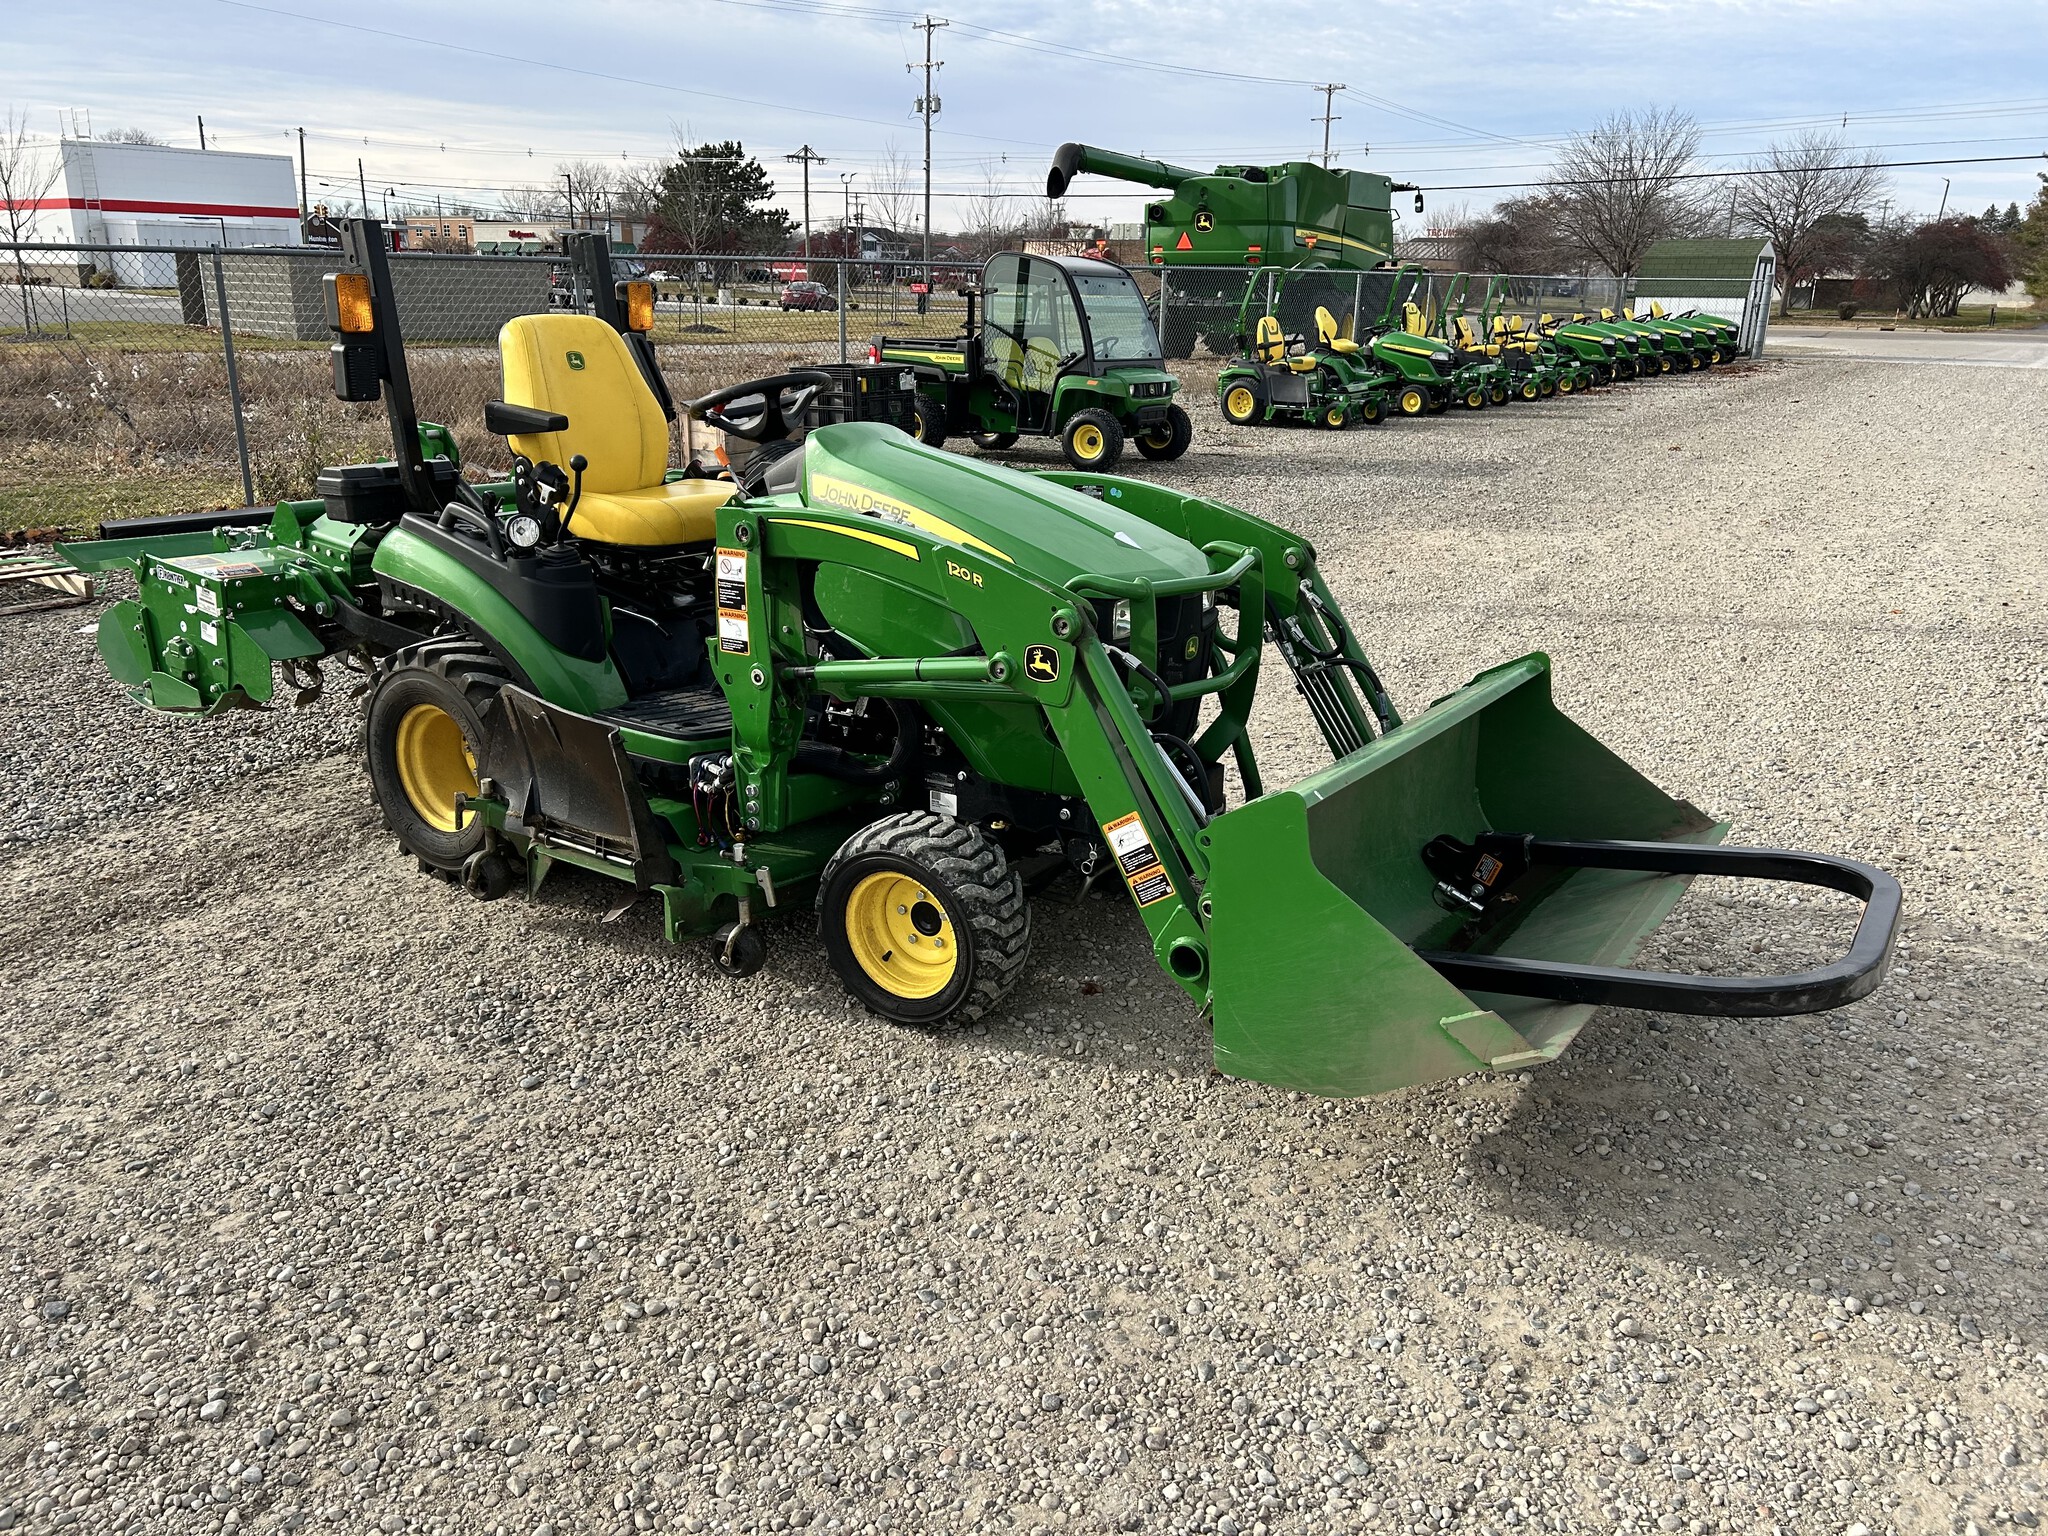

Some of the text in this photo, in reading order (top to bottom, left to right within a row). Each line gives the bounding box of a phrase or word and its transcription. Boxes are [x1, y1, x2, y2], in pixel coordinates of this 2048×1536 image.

[820, 483, 911, 522] JOHN DEERE
[723, 548, 746, 558] WARNING
[946, 560, 984, 589] 120 R
[724, 611, 747, 620] WARNING
[1113, 814, 1135, 828] WARNING
[1138, 868, 1161, 881] WARNING
